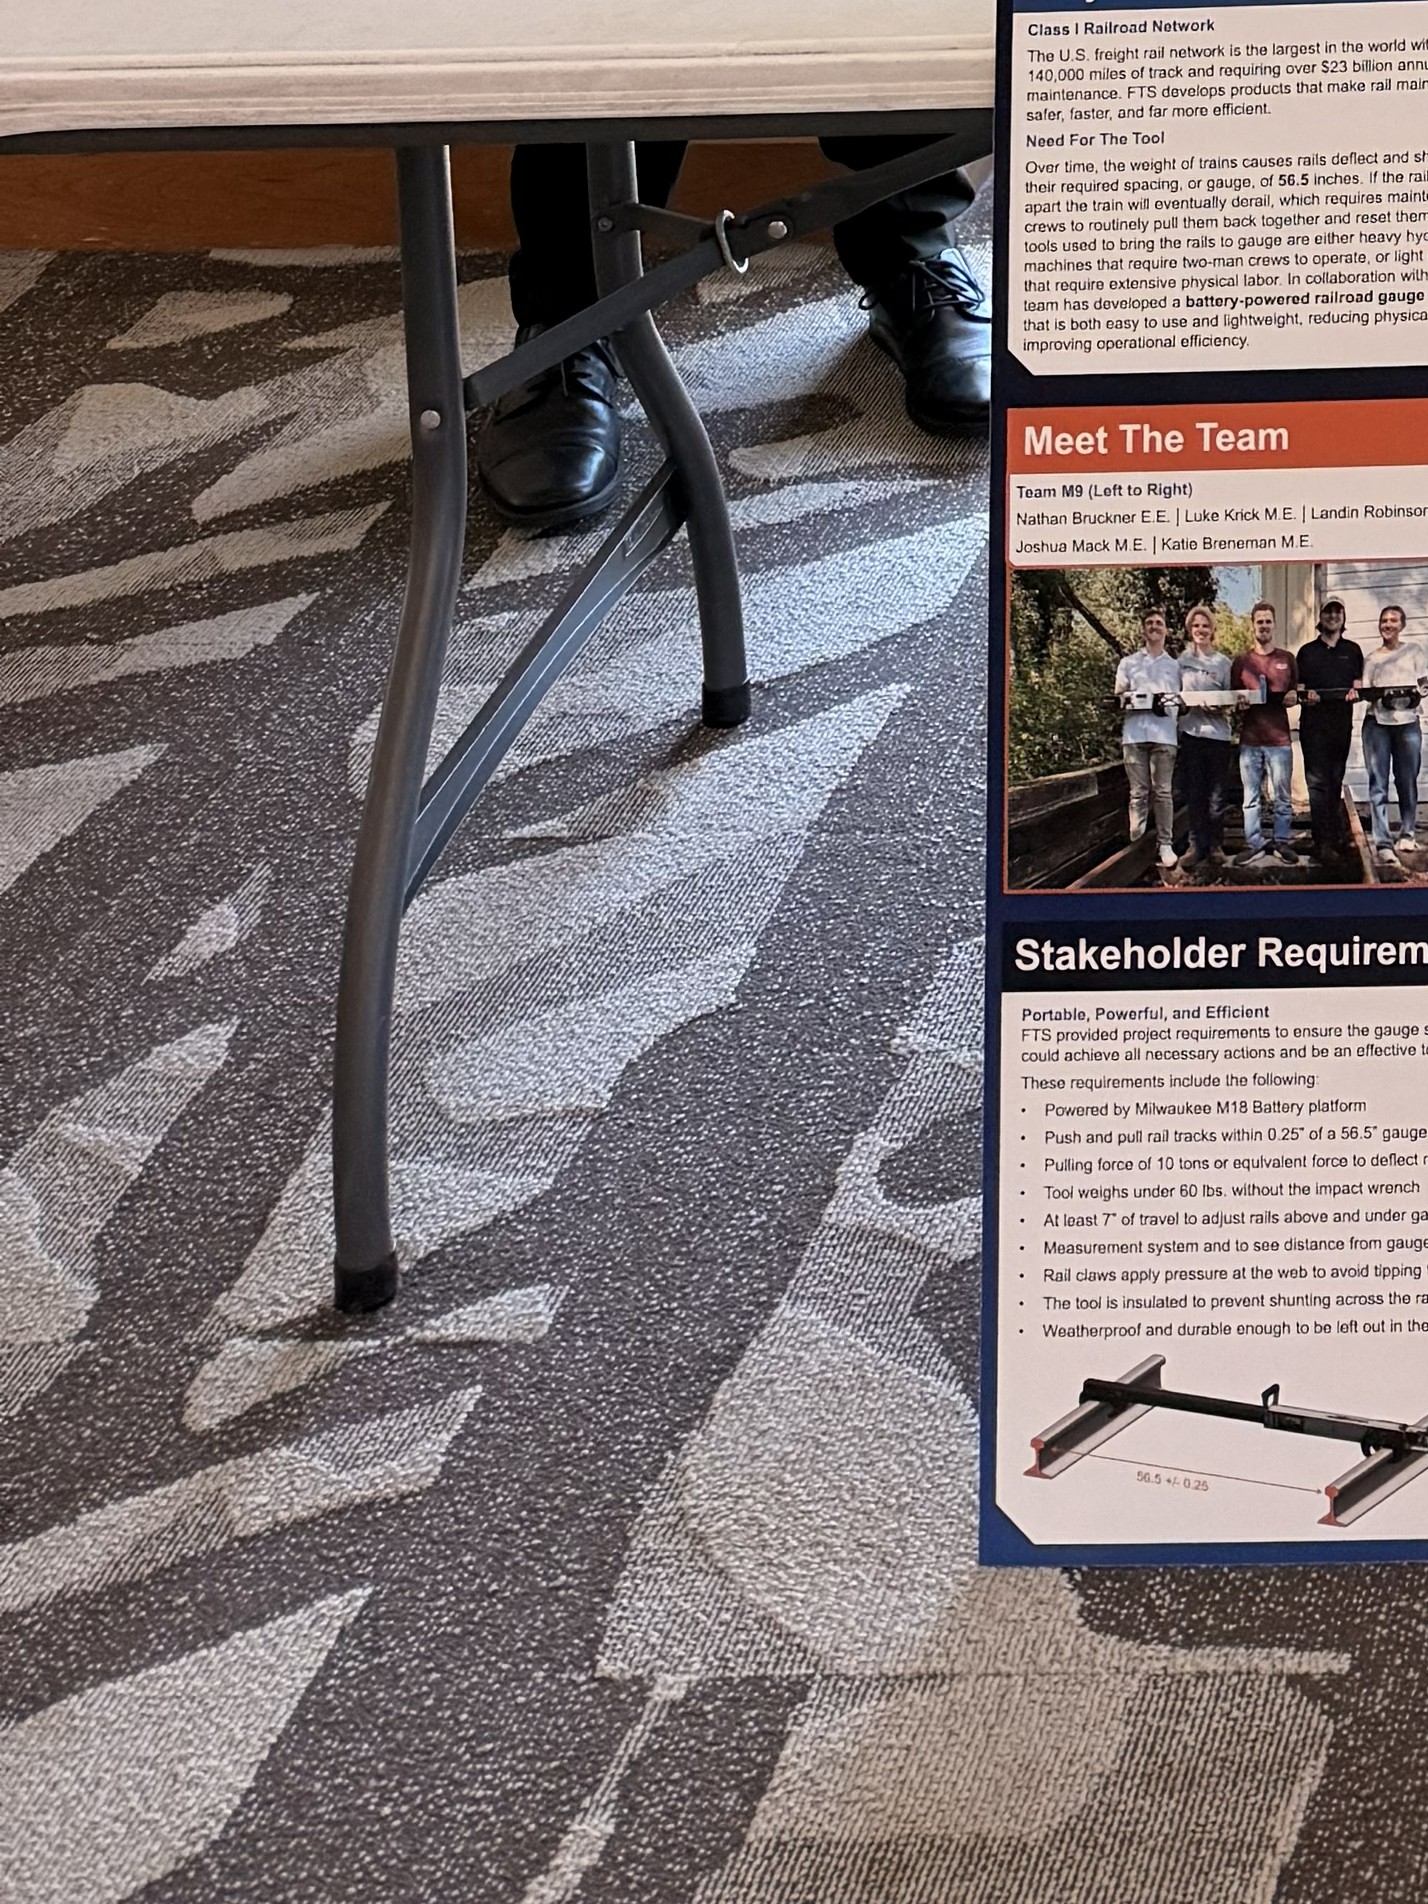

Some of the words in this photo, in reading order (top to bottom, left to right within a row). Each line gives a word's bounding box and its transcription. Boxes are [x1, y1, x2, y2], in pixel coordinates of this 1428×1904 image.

[1027, 23, 1070, 36] Class
[1084, 20, 1147, 35] Railroad
[1152, 18, 1214, 32] Network
[1026, 49, 1054, 62] The
[1059, 48, 1089, 62] U.S.
[1094, 47, 1139, 63] freight
[1143, 46, 1164, 59] rail
[1169, 44, 1225, 59] network
[1229, 44, 1241, 57] is
[1245, 43, 1267, 56] the
[1272, 42, 1320, 58] largest
[1324, 40, 1336, 53] in
[1341, 41, 1363, 53] the
[1367, 38, 1406, 52] world
[1024, 425, 1108, 455] Meet
[1118, 423, 1184, 453] The
[1195, 422, 1288, 451] Team
[1016, 485, 1056, 499] Team
[1061, 484, 1083, 498] M9
[1088, 483, 1123, 500] (Left
[1127, 484, 1142, 496] to
[1147, 482, 1193, 499] Right)
[1014, 936, 1246, 971] Stakeholder
[1021, 1007, 1090, 1022] Portable,
[1095, 1006, 1167, 1022] Powerful,
[1172, 1006, 1200, 1020] and
[1206, 1004, 1269, 1019] Efficient
